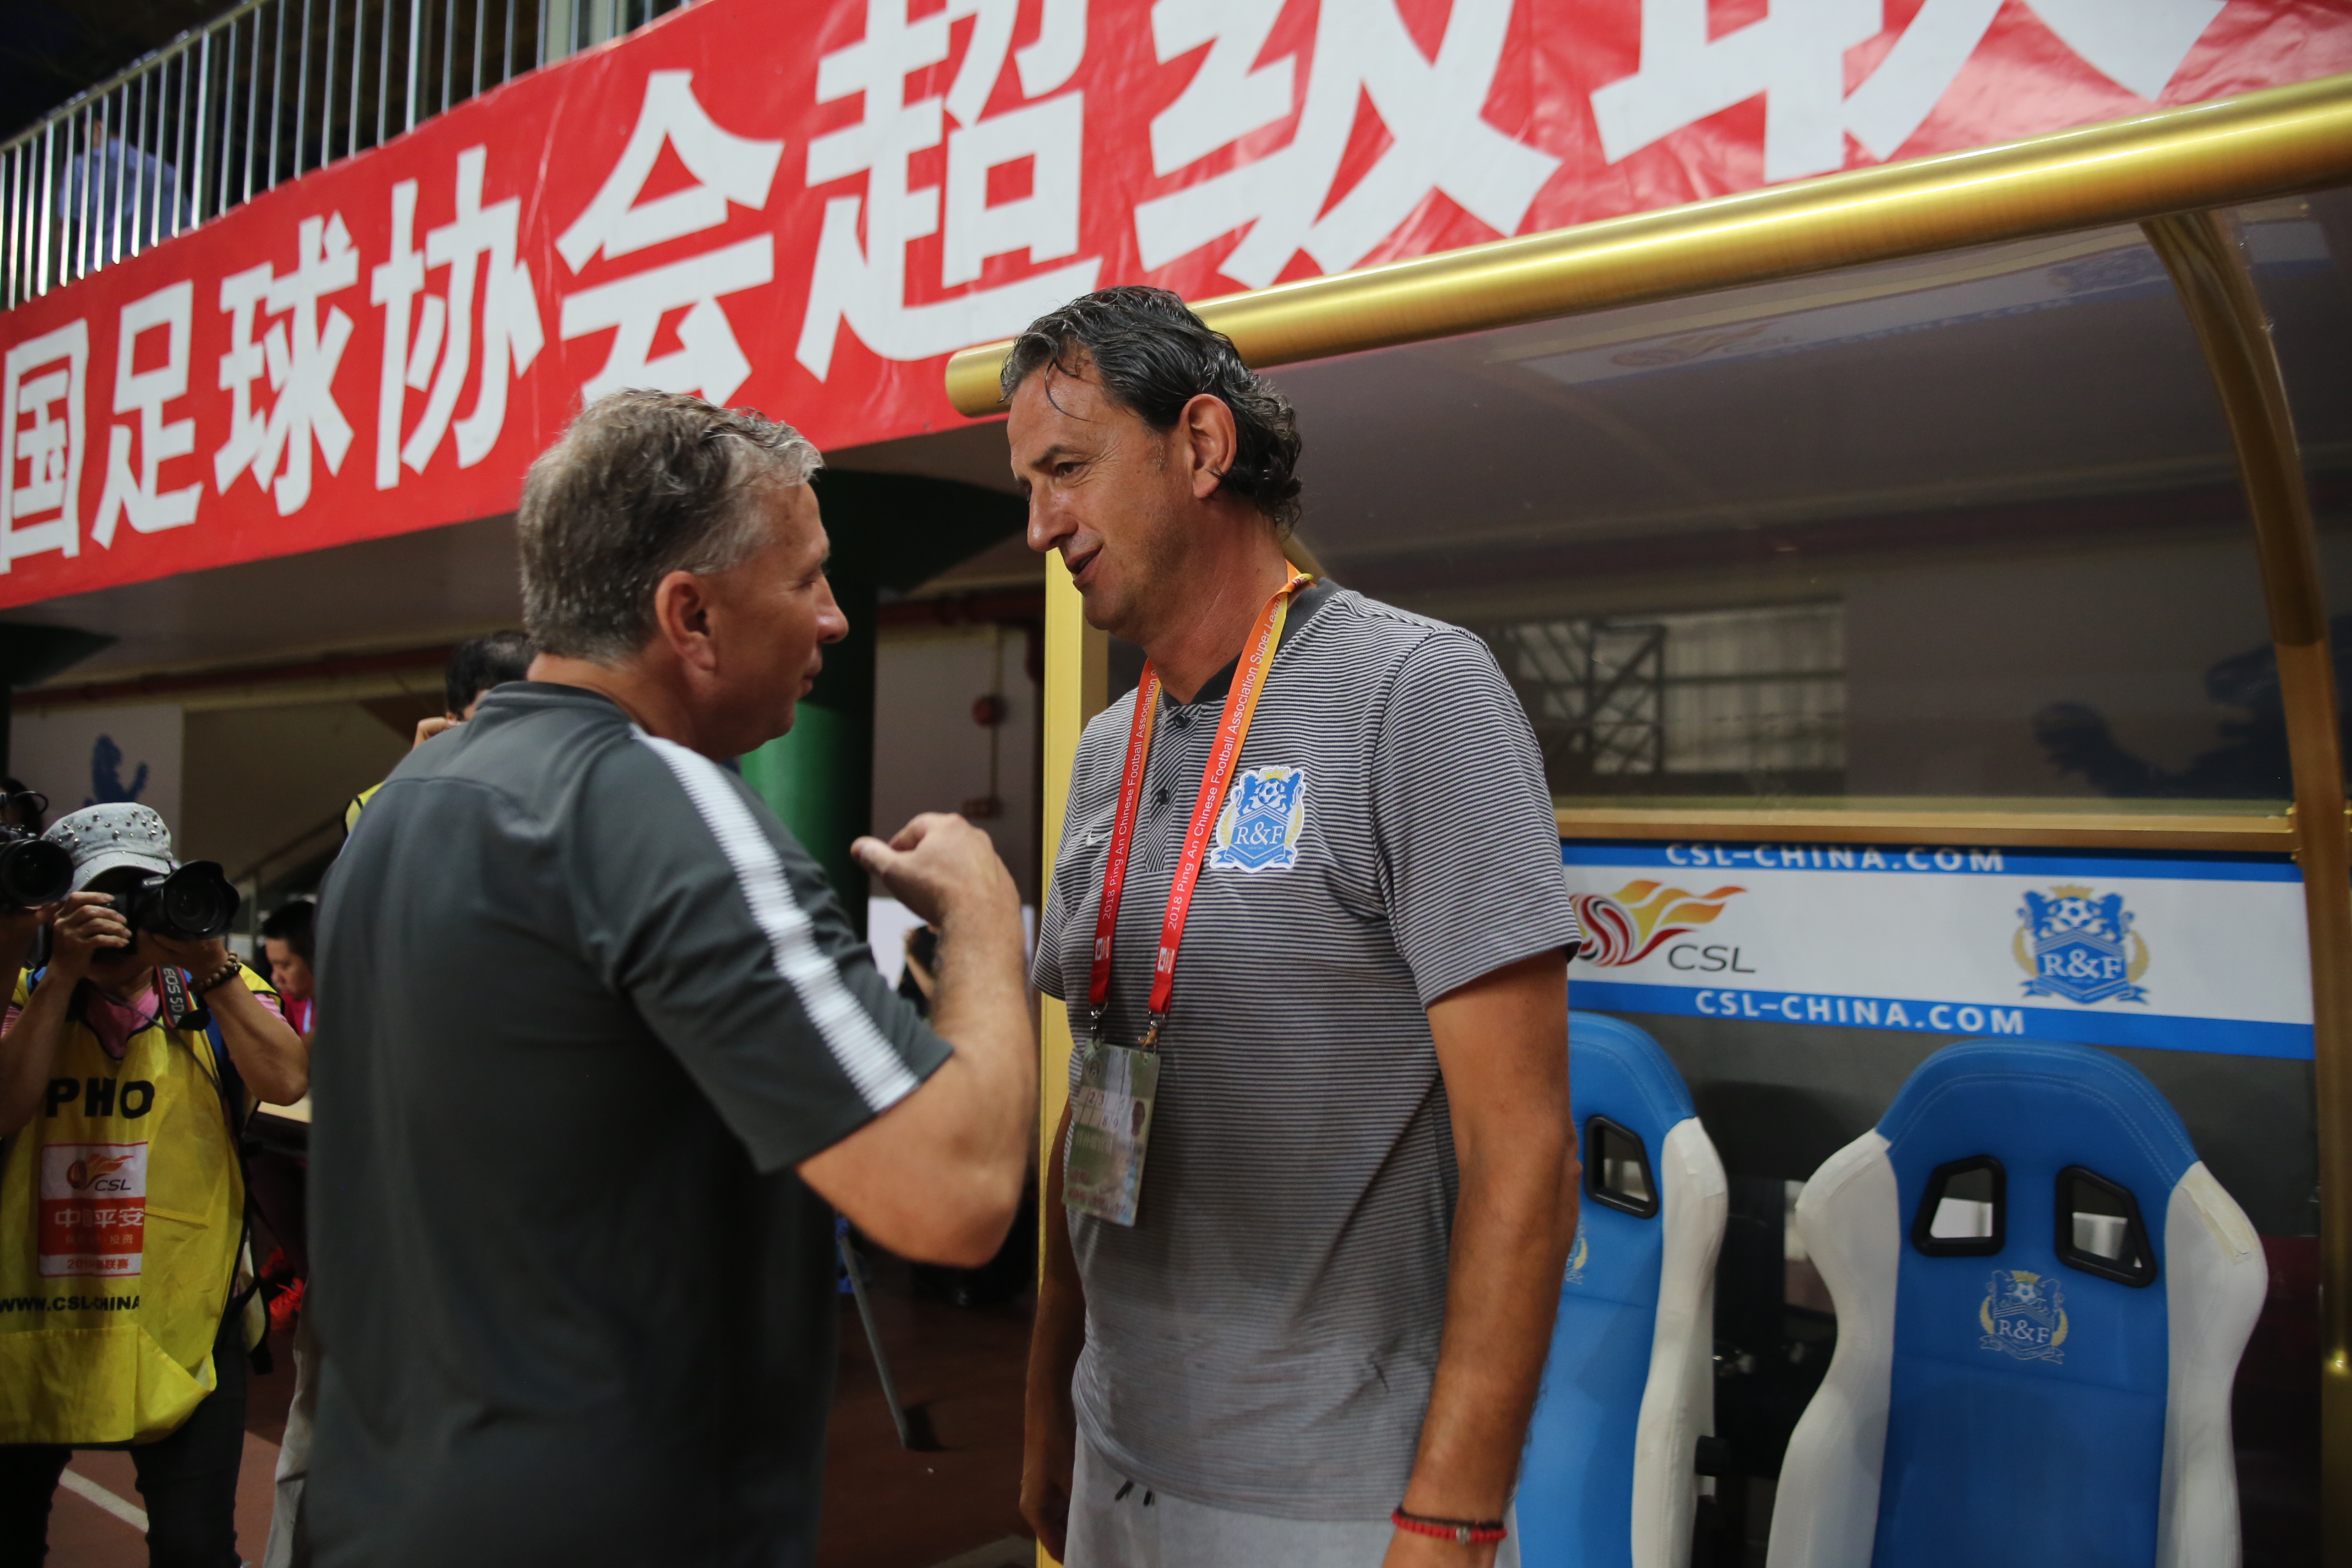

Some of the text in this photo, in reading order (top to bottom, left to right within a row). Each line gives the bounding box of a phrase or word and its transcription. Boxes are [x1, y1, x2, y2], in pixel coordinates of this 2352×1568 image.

[1136, 677, 1158, 738] Association
[1128, 741, 1142, 786] Football
[1168, 896, 1183, 930] 2018
[1177, 862, 1194, 892] Ping
[1187, 840, 1199, 859] An
[1194, 787, 1218, 837] Chinese
[1211, 736, 1235, 784] Football
[1227, 666, 1259, 735] Association
[1250, 634, 1270, 665] Super
[1118, 788, 1134, 835] Chinese
[1115, 838, 1125, 855] An
[1234, 821, 1284, 845] R&F
[1109, 859, 1123, 886] Ping
[1665, 843, 2005, 873] CSL-CHINA.COM
[1102, 889, 1115, 919] 2018
[1668, 944, 1755, 973] CSL
[2041, 949, 2123, 979] R&F
[163, 968, 181, 994] EOS
[170, 997, 184, 1012] 5D
[1695, 990, 2025, 1035] CSL-CHINA.COM
[95, 1179, 132, 1191] CSL
[1998, 1319, 2051, 1343] R&F
